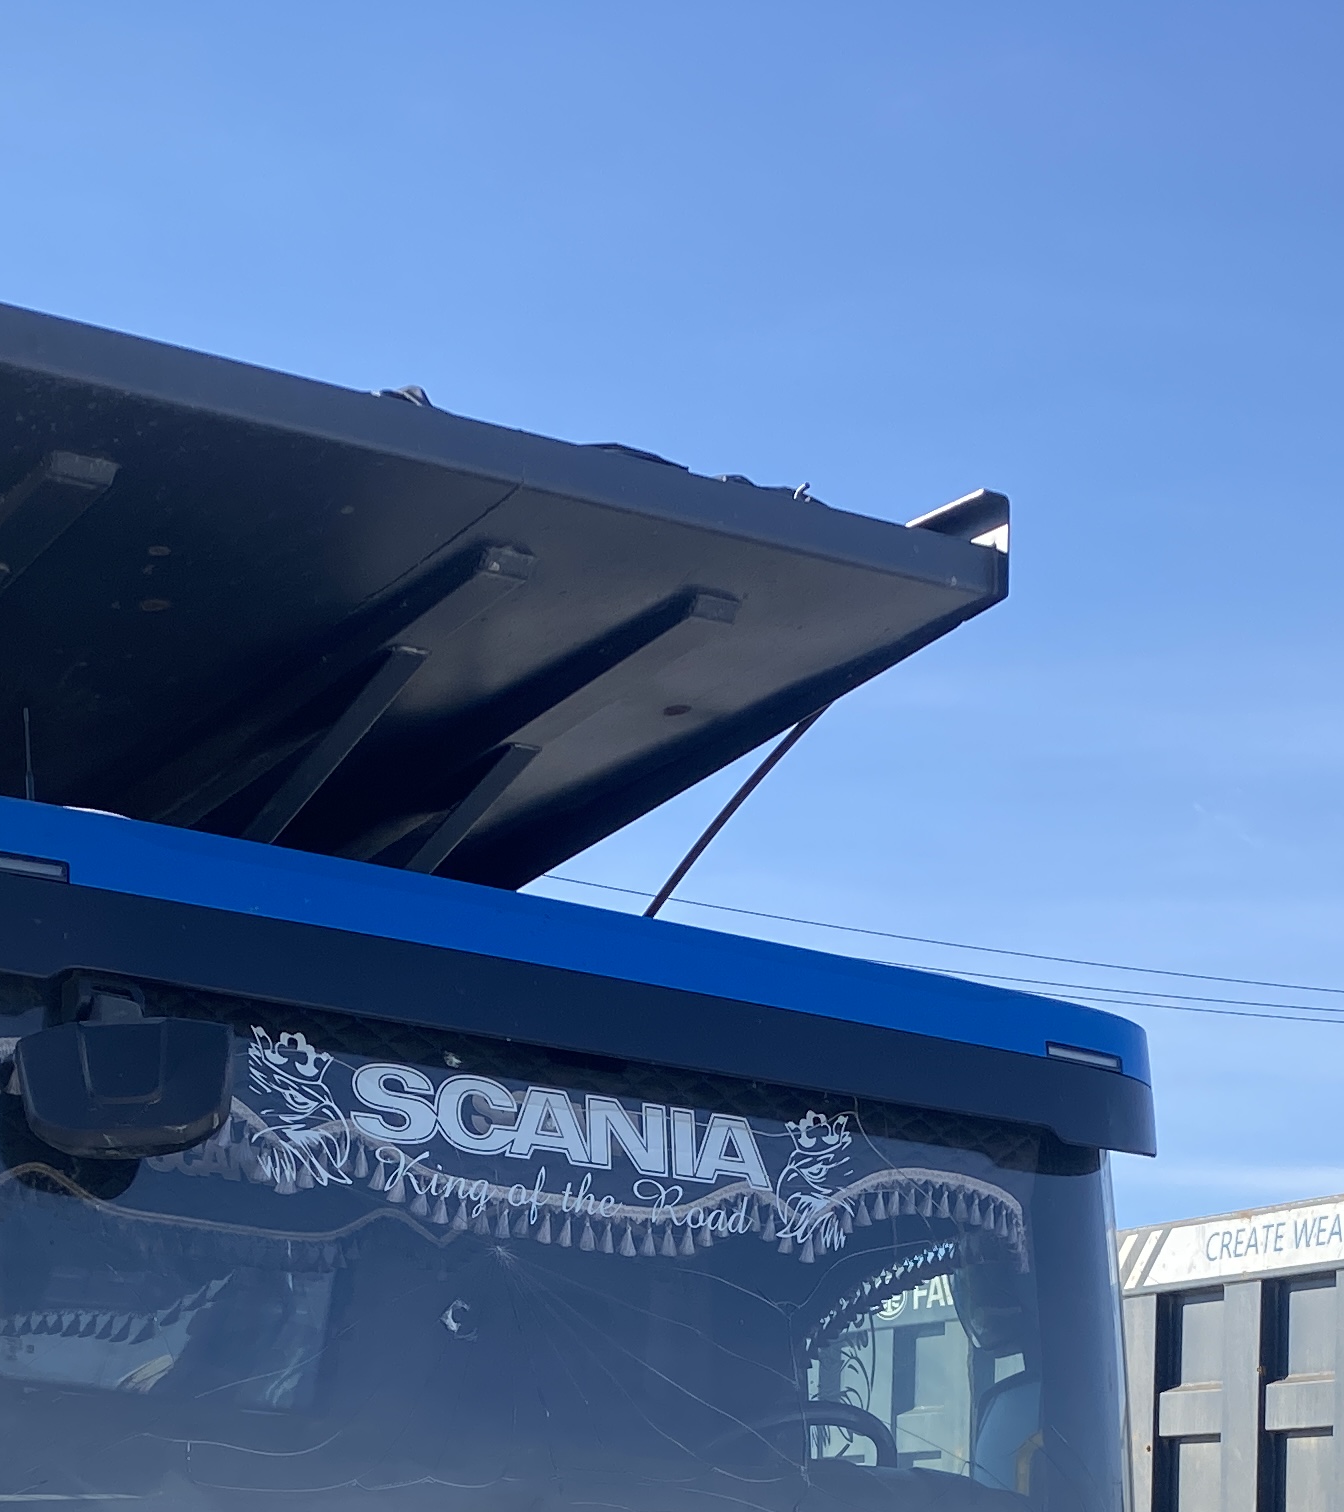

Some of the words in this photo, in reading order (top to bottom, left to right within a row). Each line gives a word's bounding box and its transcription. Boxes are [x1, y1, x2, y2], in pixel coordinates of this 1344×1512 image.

[351, 1062, 773, 1191] SCANIA
[375, 1146, 492, 1219] King
[508, 1166, 549, 1225] of
[562, 1172, 621, 1218] the
[633, 1179, 755, 1235] Road
[1205, 1222, 1284, 1262] CREATE
